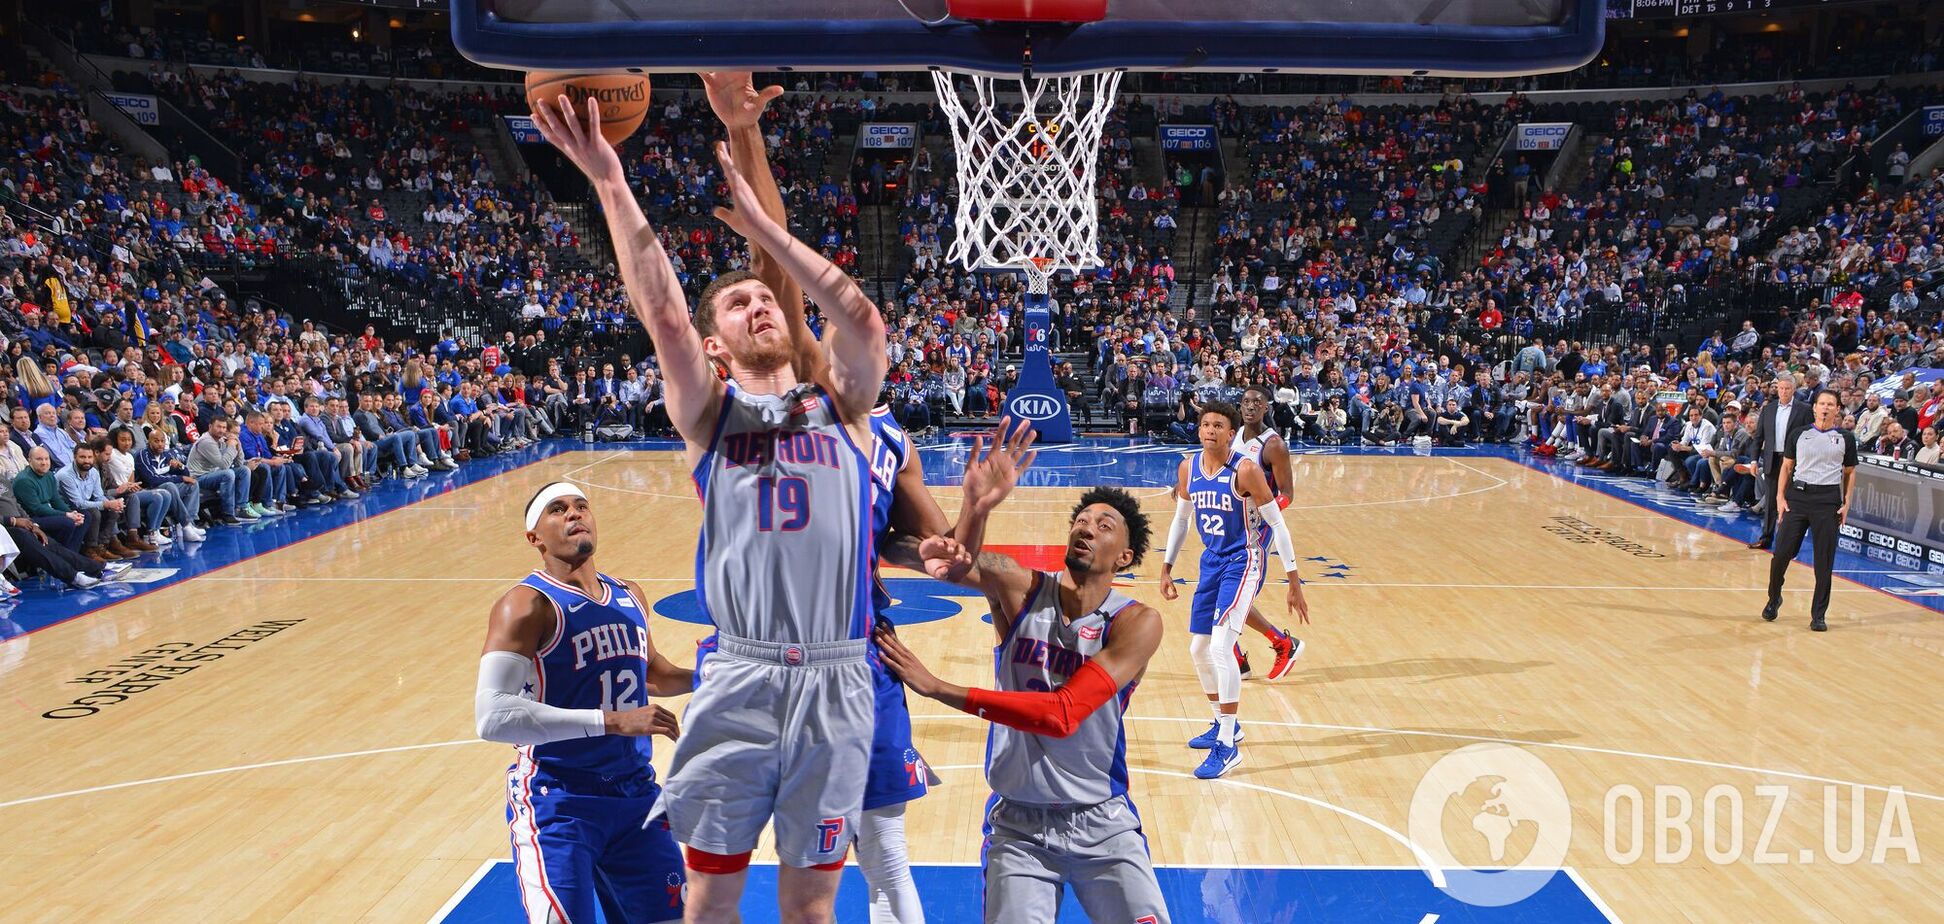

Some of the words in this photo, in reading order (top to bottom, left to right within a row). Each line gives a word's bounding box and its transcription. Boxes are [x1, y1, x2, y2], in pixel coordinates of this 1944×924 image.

[1682, 5, 1700, 14] DET
[1706, 4, 1716, 12] 15
[1727, 2, 1734, 10] 9
[564, 81, 645, 104] SPALDING
[870, 126, 909, 135] GEICO
[1167, 128, 1207, 137] GEICO
[1525, 127, 1566, 136] GEICO
[865, 137, 882, 146] 108
[897, 137, 913, 146] 107
[1162, 139, 1179, 149] 107
[1194, 139, 1212, 149] 106
[1519, 138, 1537, 148] 106
[1028, 328, 1046, 342] 76
[1020, 400, 1053, 415] KIA
[724, 427, 841, 471] DETROIT
[757, 476, 811, 532] 19
[1190, 490, 1234, 511] PHILA
[1200, 513, 1225, 536] 22
[1840, 524, 1863, 539] GEICO
[1868, 531, 1895, 549] GEICO
[1897, 540, 1922, 557] GEICO
[1928, 549, 1944, 564] GEI
[173, 618, 307, 662] WELLS
[65, 642, 194, 684] CENTER
[41, 664, 201, 719] FARGO
[600, 669, 639, 712] 12
